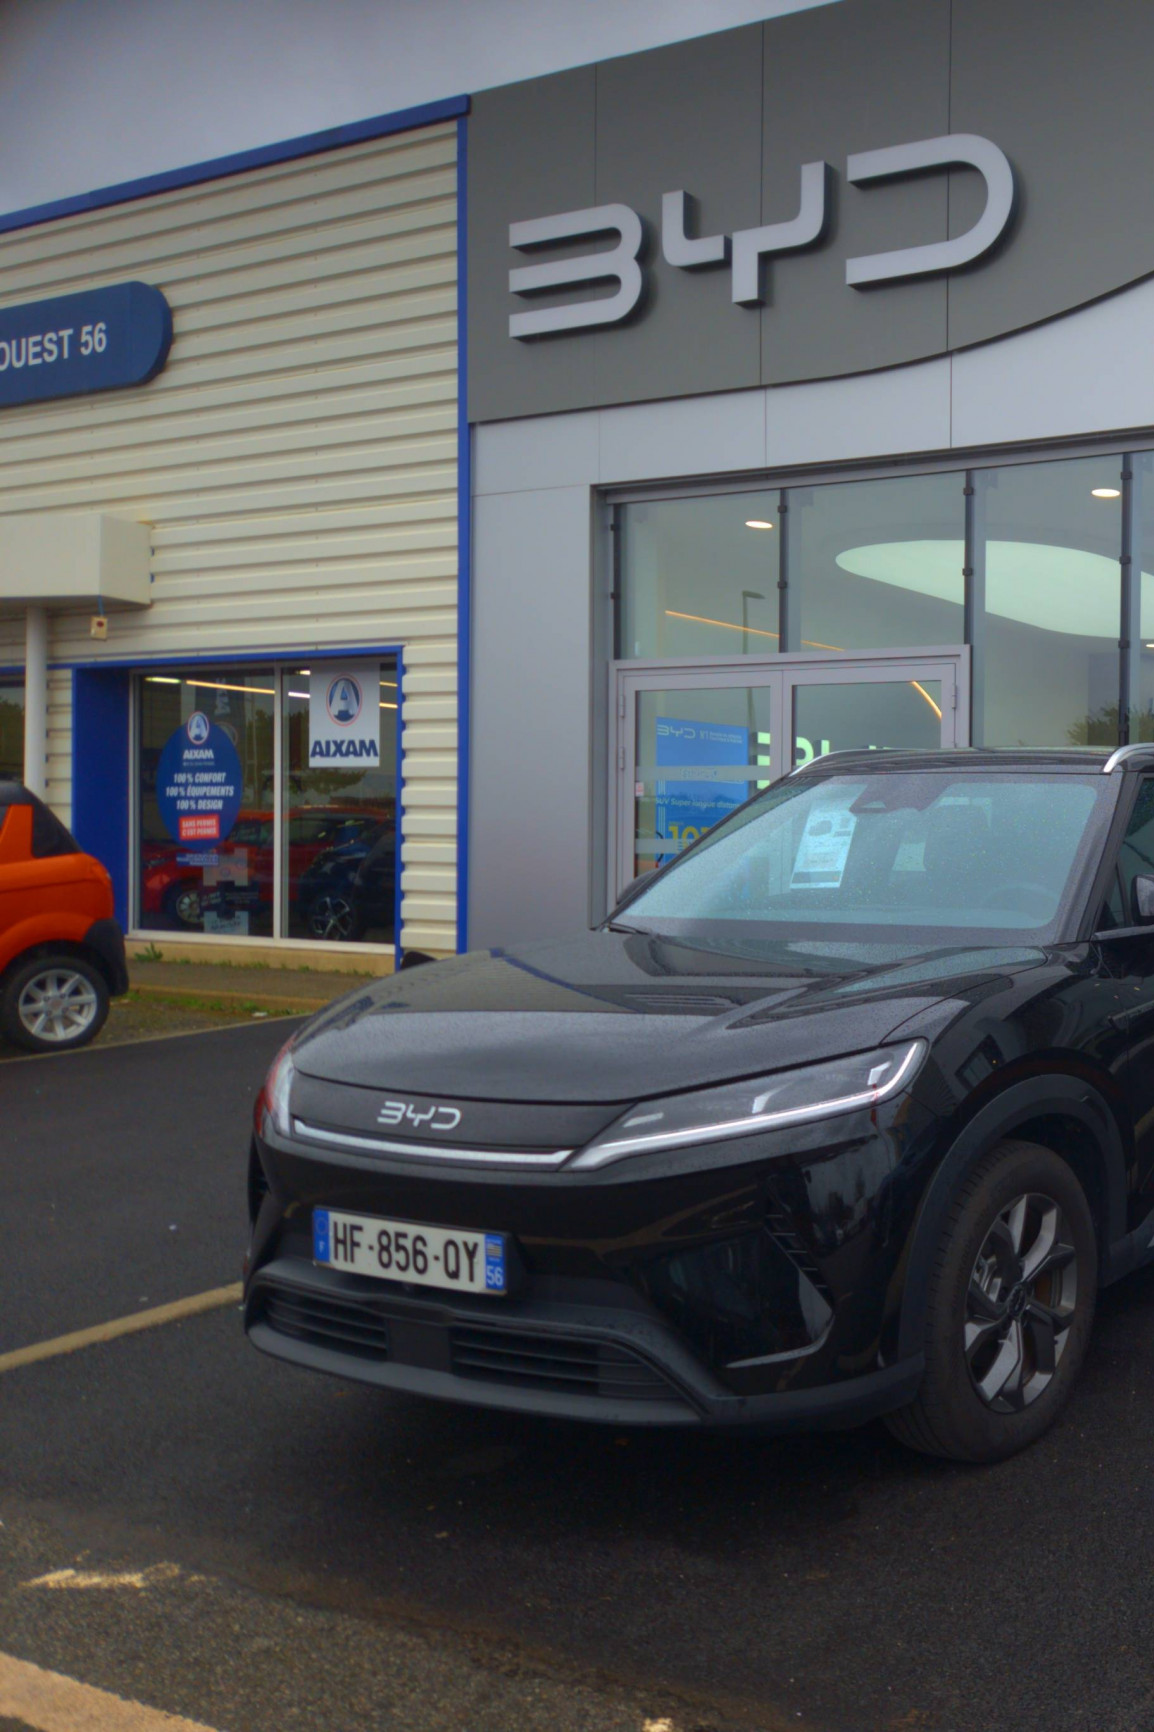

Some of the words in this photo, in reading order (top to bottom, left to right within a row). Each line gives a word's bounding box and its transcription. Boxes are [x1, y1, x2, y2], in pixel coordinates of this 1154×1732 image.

[509, 133, 1017, 340] BYD
[80, 322, 107, 355] 56
[656, 724, 696, 739] BYD
[183, 749, 215, 760] AIXAM
[310, 739, 379, 758] AIXAM
[195, 772, 226, 783] CONFORT
[197, 799, 223, 810] DESIGN
[671, 797, 691, 808] Super
[377, 1100, 462, 1130] BYD
[333, 1220, 479, 1284] HF-856-QY
[486, 1265, 504, 1287] 56
